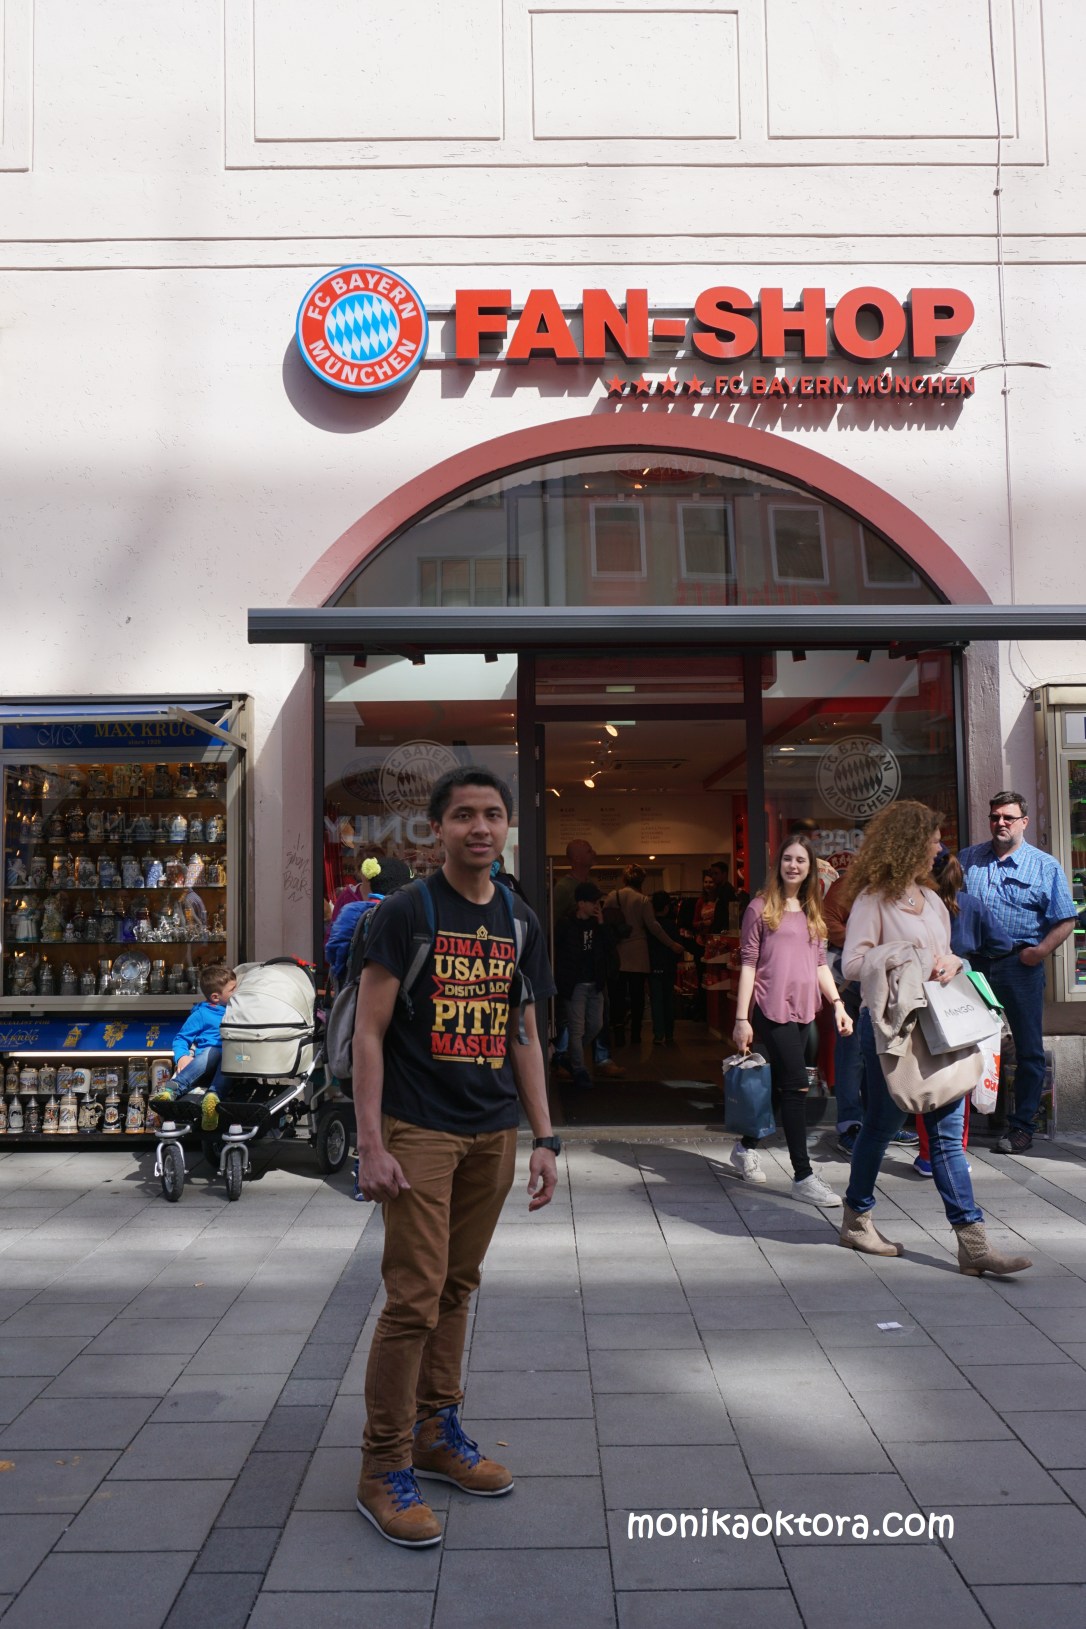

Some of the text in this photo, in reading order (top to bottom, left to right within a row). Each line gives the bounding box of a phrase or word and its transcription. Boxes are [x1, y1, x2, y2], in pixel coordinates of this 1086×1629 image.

[307, 272, 418, 321] FC BAYERN
[454, 285, 976, 362] FAN-SHOP
[308, 338, 417, 384] MÜNCHEN
[715, 372, 976, 395] FC BAYERN MÜNCHEN
[94, 721, 196, 737] MAX KRUG
[386, 758, 402, 778] FC
[823, 755, 839, 772] FC
[434, 936, 485, 958] DIMA
[444, 983, 486, 997] DISITU
